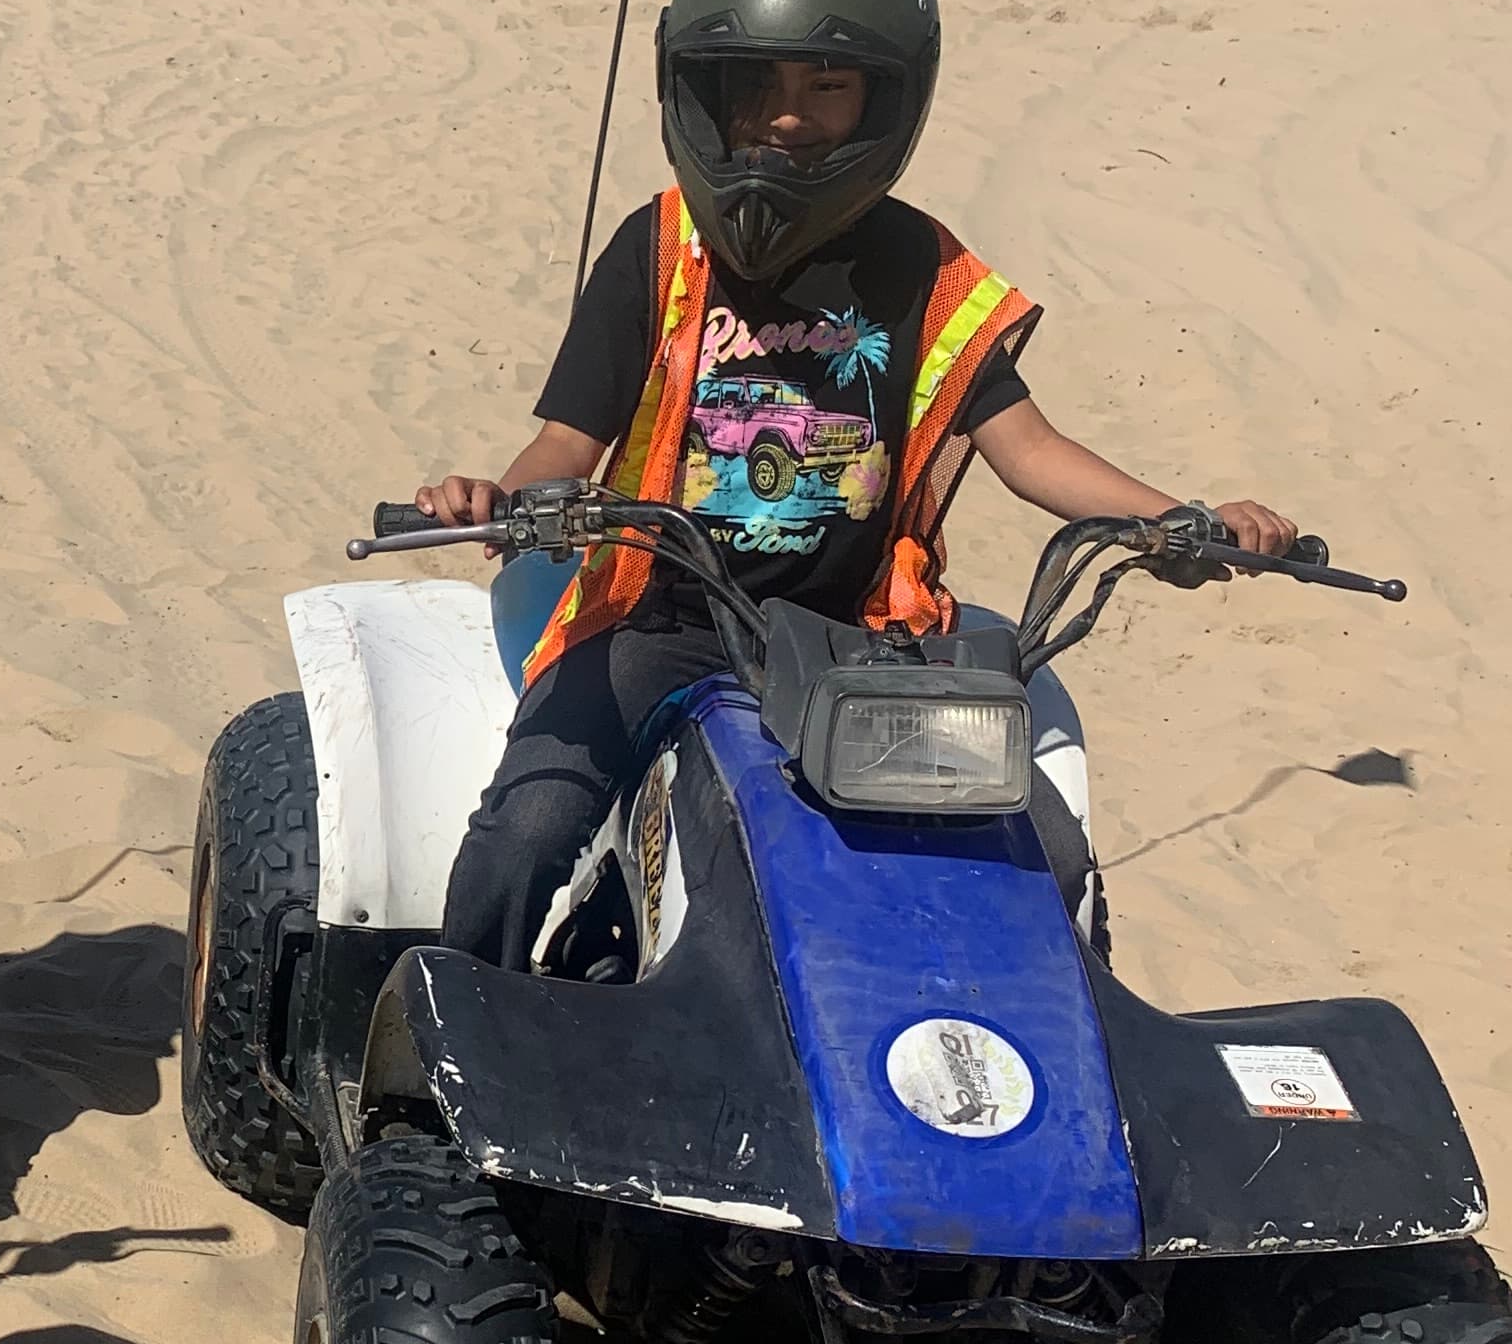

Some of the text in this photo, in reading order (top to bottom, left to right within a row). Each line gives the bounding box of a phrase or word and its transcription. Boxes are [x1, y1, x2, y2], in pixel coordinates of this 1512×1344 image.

[710, 515, 826, 555] BY Ford
[1280, 1082, 1301, 1092] 16
[1278, 1090, 1313, 1101] UNDER
[1268, 1106, 1324, 1117] WARNING
